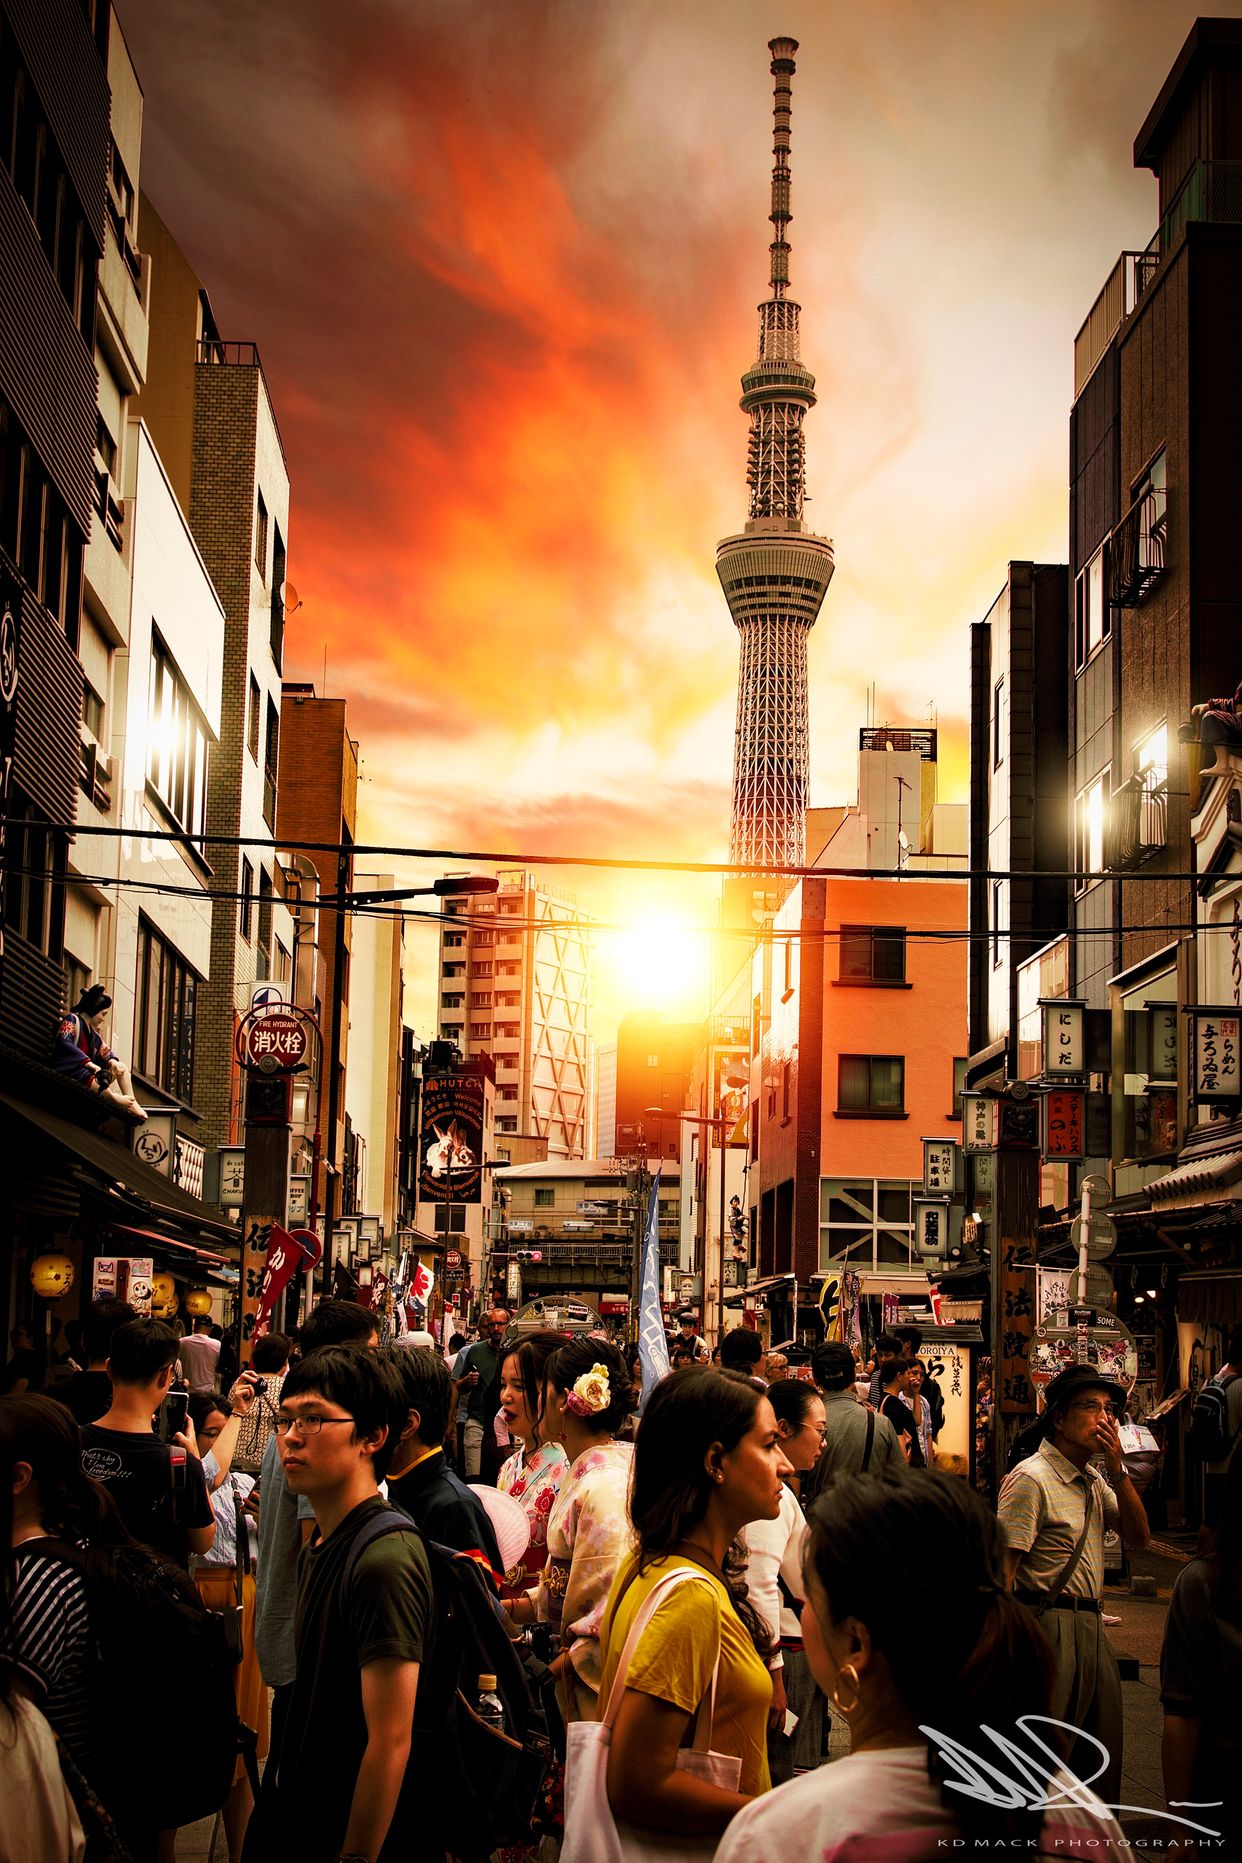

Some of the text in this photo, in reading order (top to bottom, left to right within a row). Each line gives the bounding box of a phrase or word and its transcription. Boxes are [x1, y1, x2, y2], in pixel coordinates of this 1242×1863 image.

[254, 1030, 303, 1054] 消火栓
[1058, 1013, 1072, 1065] にしだ
[1221, 1038, 1236, 1075] らめん
[1069, 1095, 1079, 1153] ステーキハウス
[929, 1154, 940, 1187] 駐車場
[941, 1147, 951, 1185] 時間貸し
[1003, 1245, 1033, 1404] 伝法院通
[1097, 1316, 1116, 1327] SOME
[920, 1347, 955, 1355] OROIYA
[951, 1355, 963, 1397] 浅草名代
